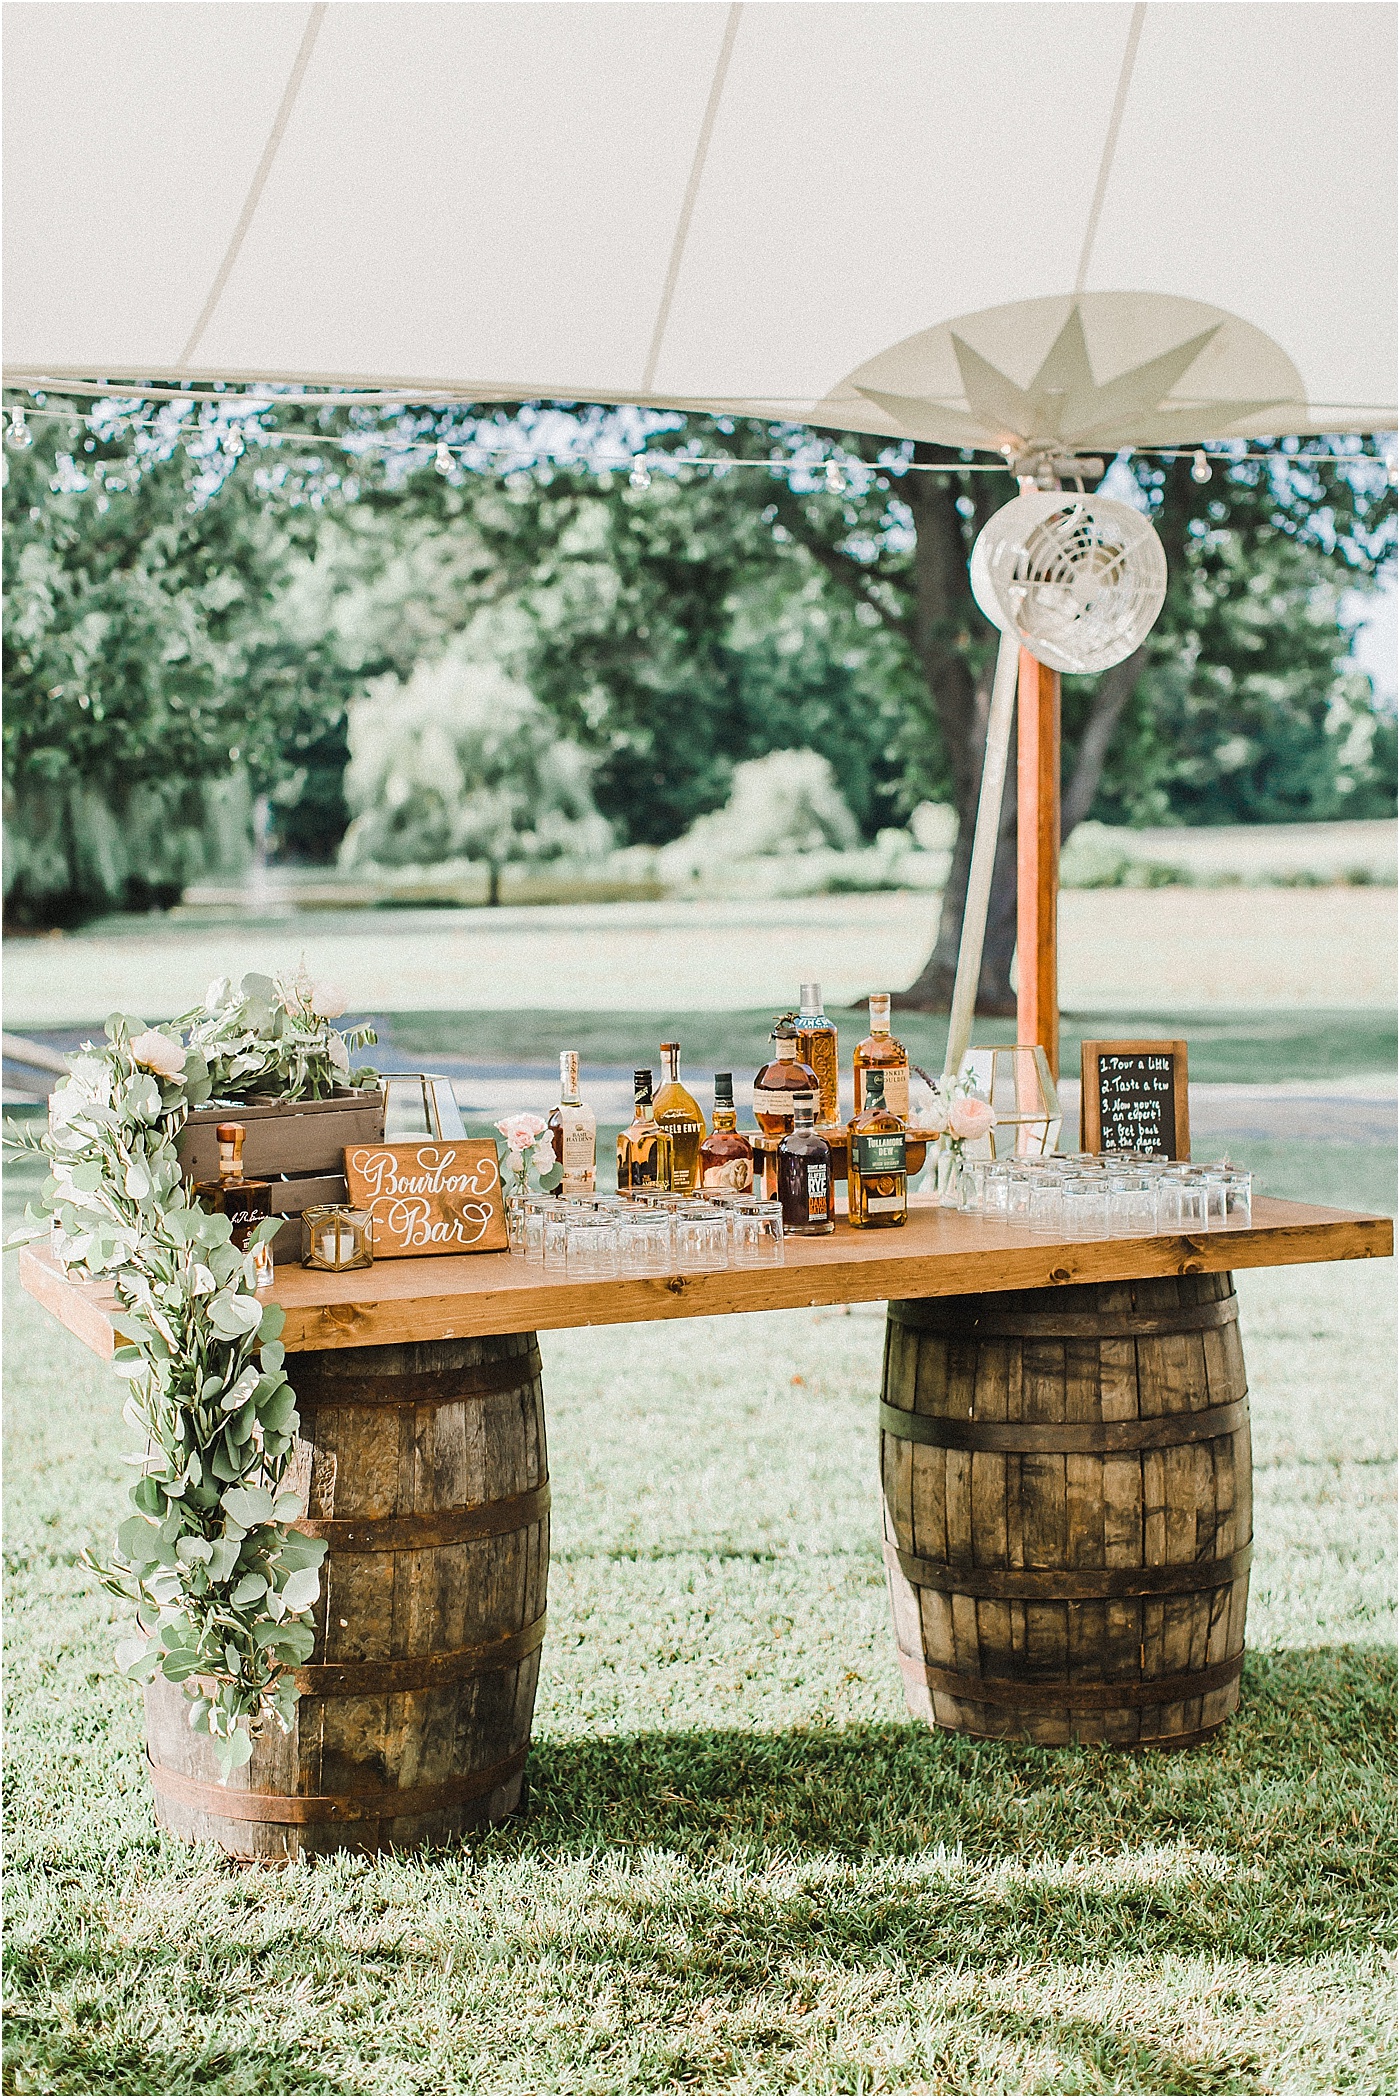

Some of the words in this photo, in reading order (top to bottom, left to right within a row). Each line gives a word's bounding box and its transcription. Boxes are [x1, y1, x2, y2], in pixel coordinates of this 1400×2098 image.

[1138, 1060, 1144, 1069] a
[1143, 1082, 1150, 1091] a
[1153, 1077, 1169, 1091] few
[1112, 1098, 1131, 1112] Now
[1112, 1112, 1124, 1121] an
[1117, 1123, 1135, 1137] Get
[1138, 1123, 1159, 1135] back
[866, 1137, 904, 1148] TULLAMORE
[1105, 1139, 1117, 1148] on
[1118, 1137, 1133, 1147] the
[1136, 1136, 1162, 1147] dance
[878, 1147, 894, 1156] DEW
[352, 1147, 499, 1197] Bourbon
[808, 1178, 827, 1192] RYE
[388, 1196, 494, 1248] Bar
